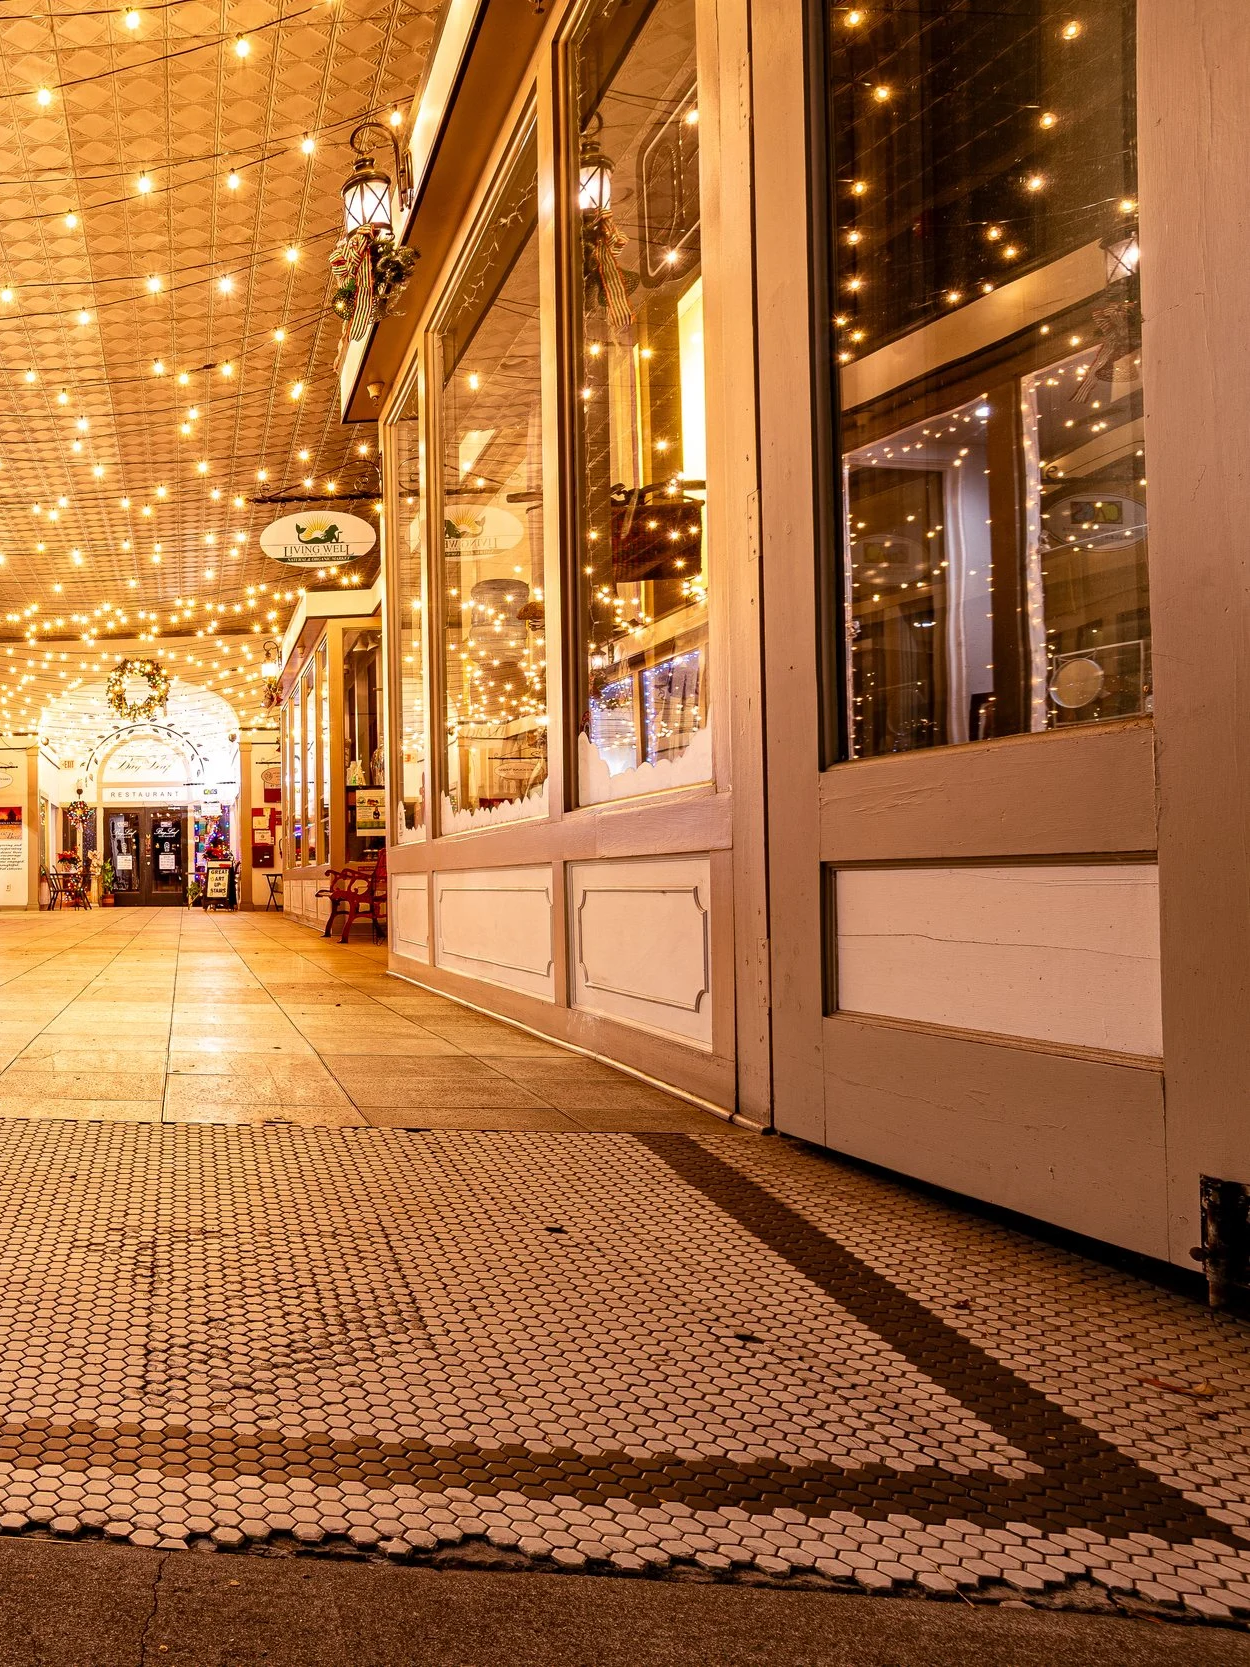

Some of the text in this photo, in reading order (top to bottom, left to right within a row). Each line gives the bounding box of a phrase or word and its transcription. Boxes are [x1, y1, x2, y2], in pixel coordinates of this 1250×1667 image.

[284, 544, 354, 557] LIVING WELL
[64, 760, 75, 769] EXIT
